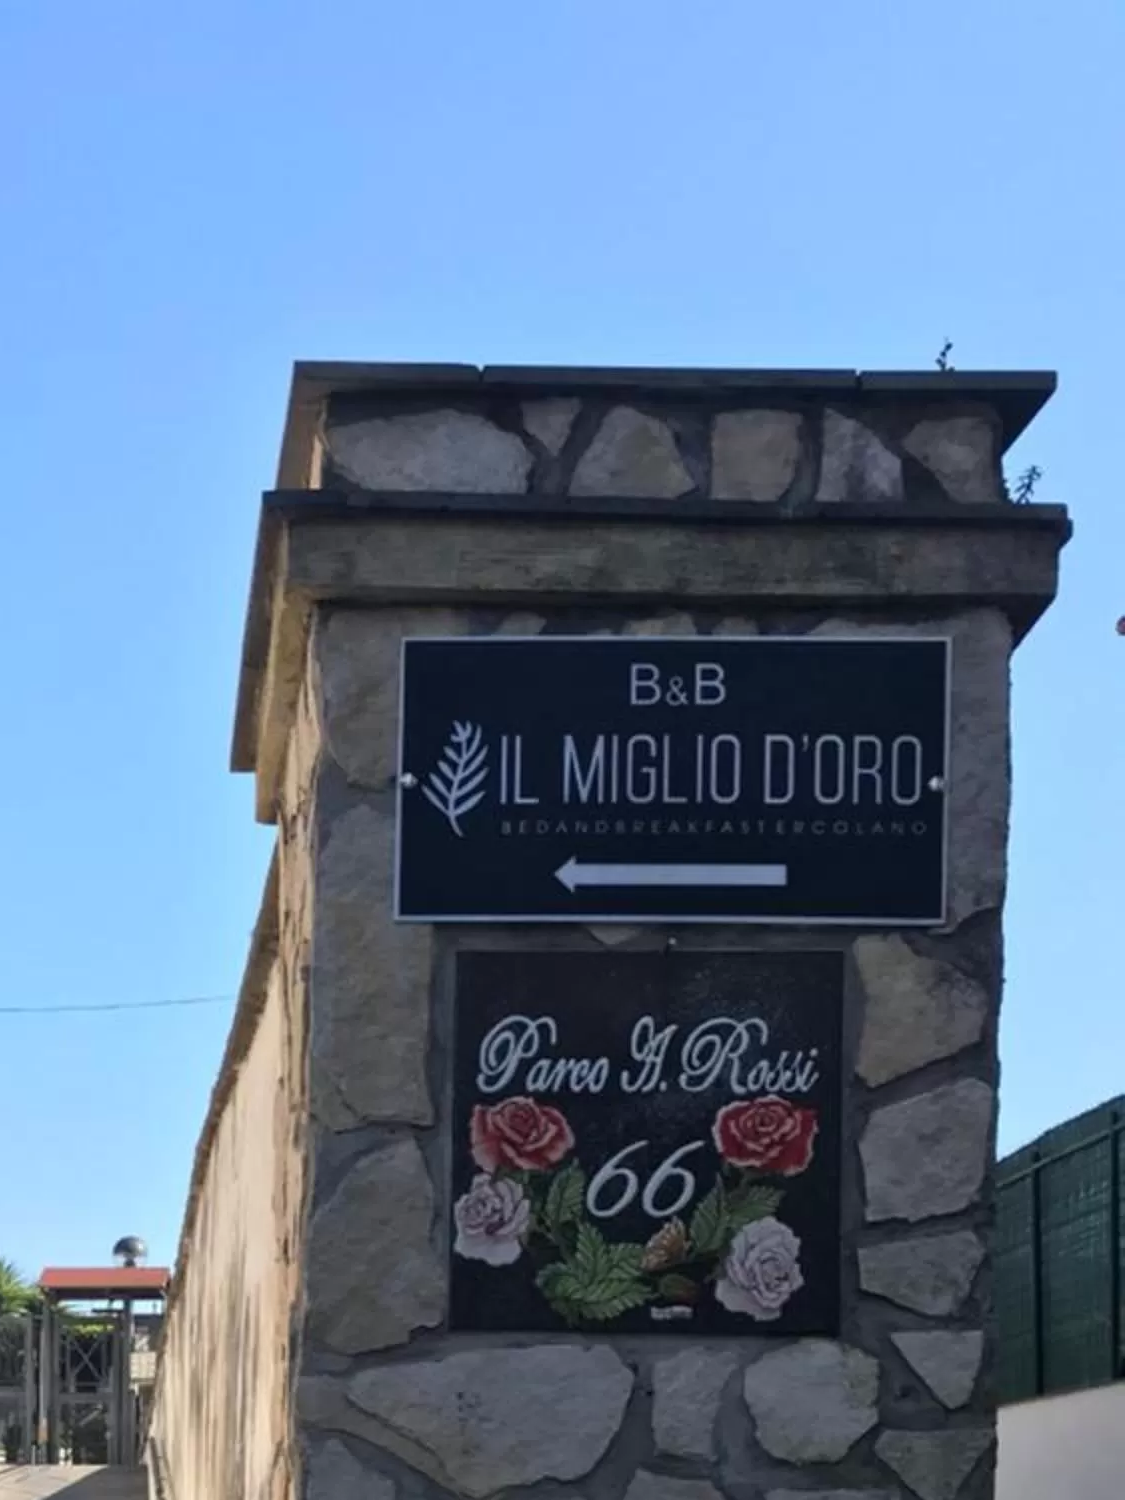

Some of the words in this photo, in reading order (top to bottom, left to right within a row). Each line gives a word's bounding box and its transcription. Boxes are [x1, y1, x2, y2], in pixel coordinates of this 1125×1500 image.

[629, 662, 727, 706] B&B
[498, 734, 540, 805] IL
[562, 734, 741, 805] MIGLIO
[763, 734, 924, 806] D'ORO
[475, 1014, 610, 1094] Parco
[678, 1016, 820, 1095] Rossi
[585, 1139, 706, 1219] 66
